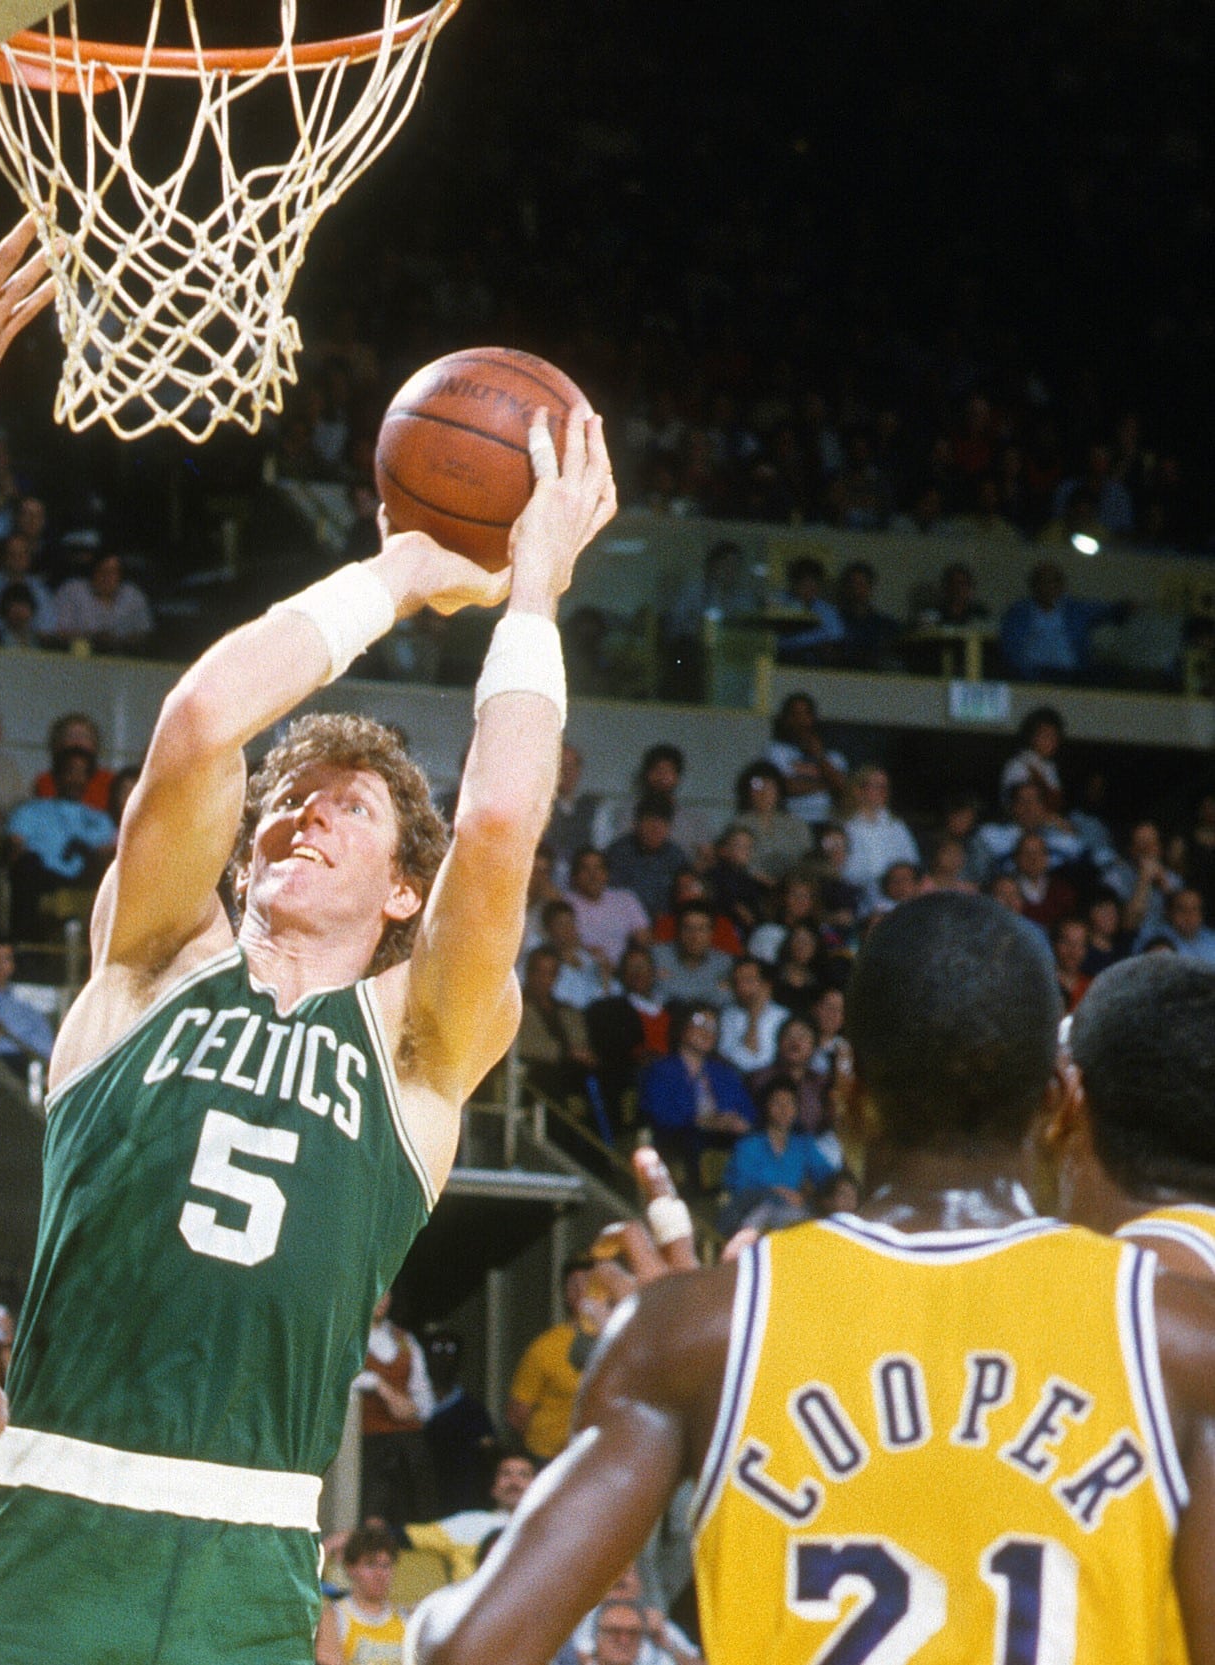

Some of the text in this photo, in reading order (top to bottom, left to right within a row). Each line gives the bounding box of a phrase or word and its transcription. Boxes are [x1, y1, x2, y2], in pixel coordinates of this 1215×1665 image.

[143, 1006, 368, 1141] CELTICS
[178, 1108, 300, 1267] 5
[733, 1351, 1148, 1531] COOPER
[788, 1535, 1079, 1665] 21
